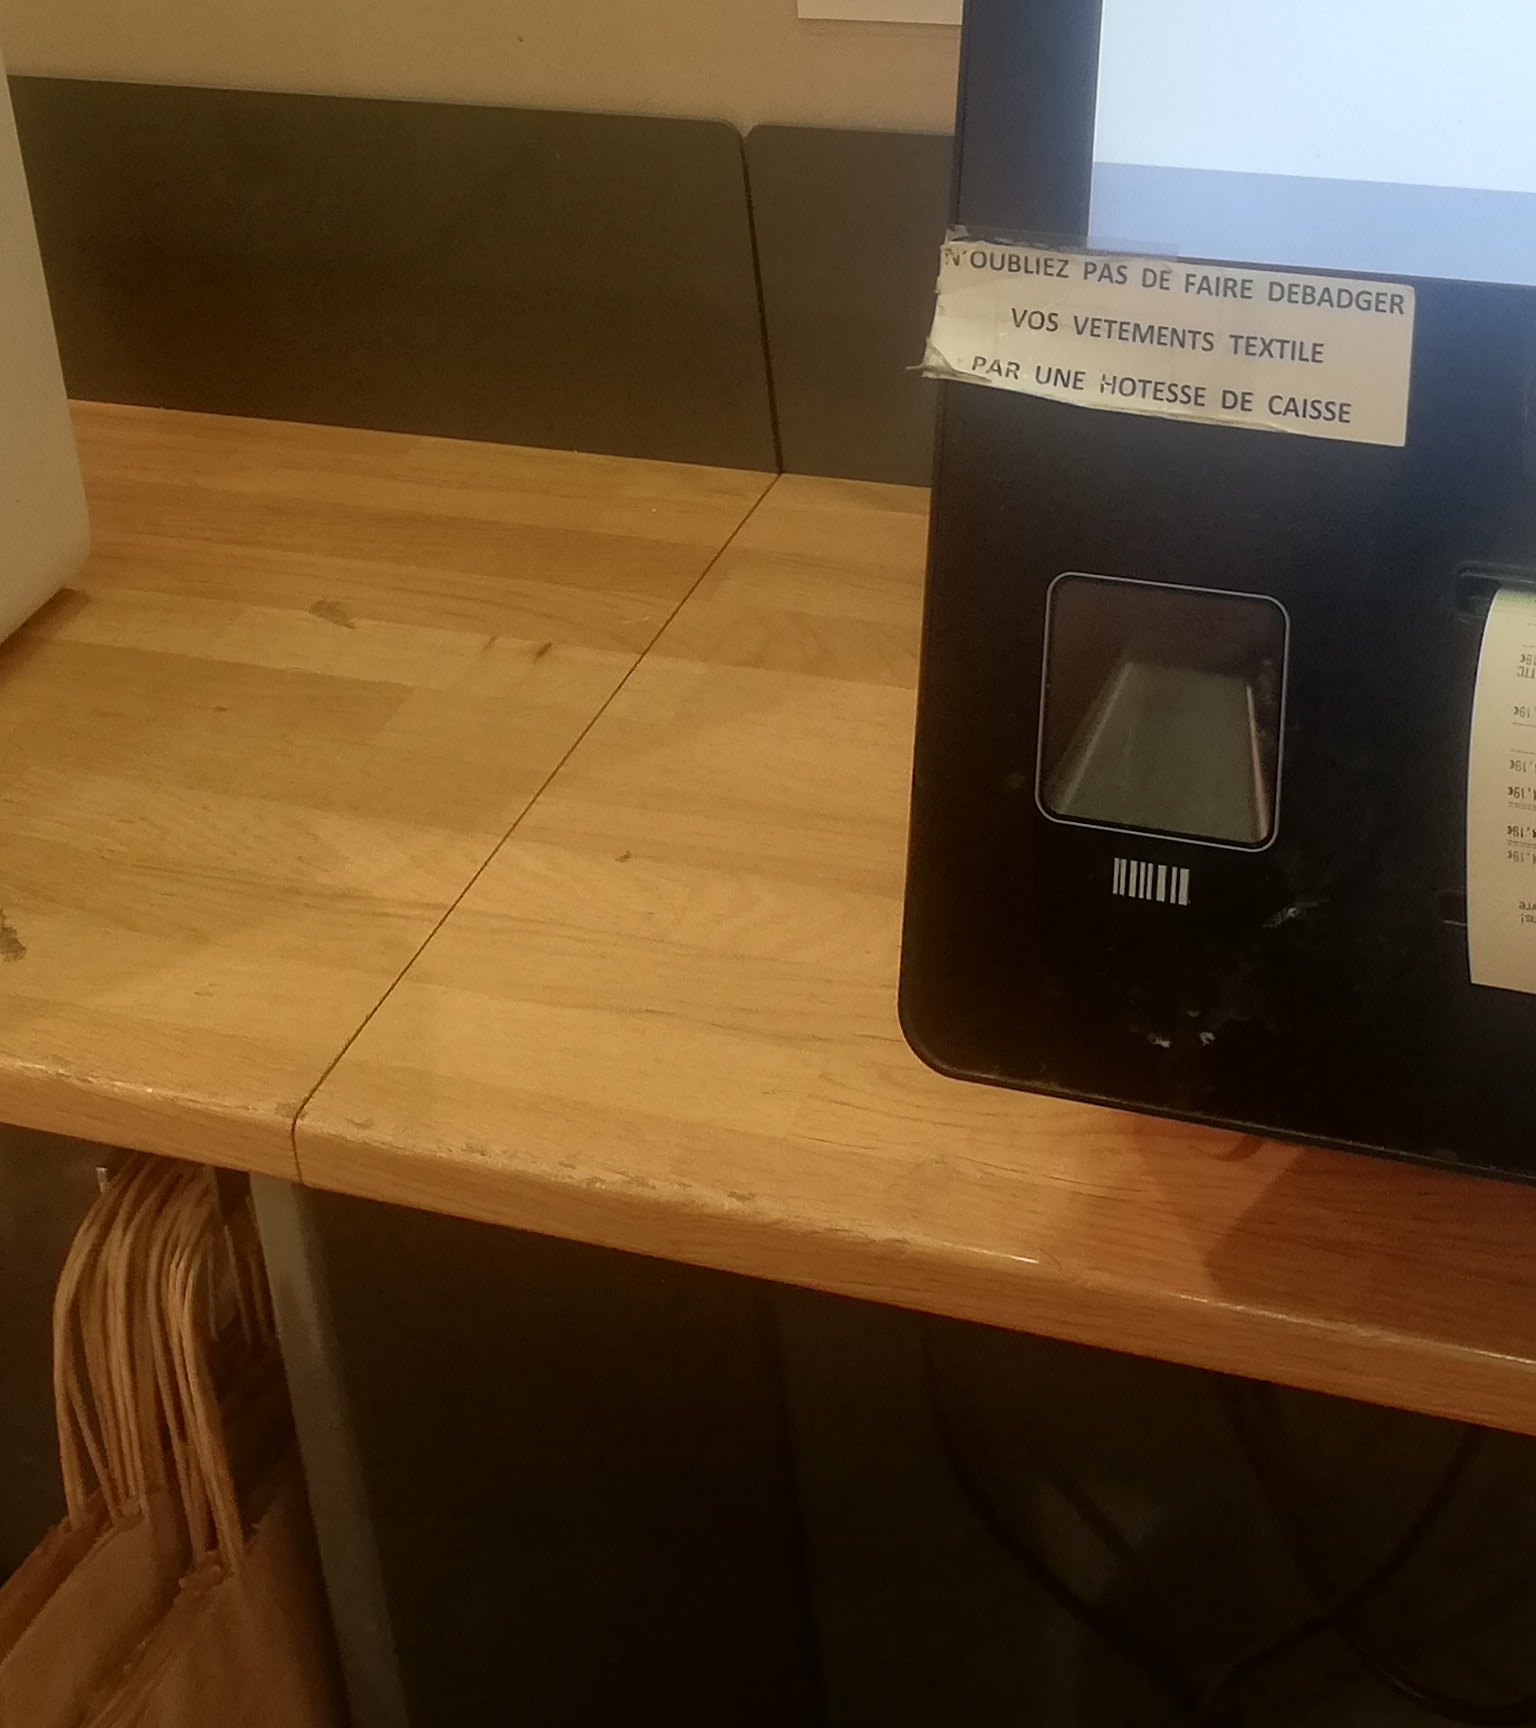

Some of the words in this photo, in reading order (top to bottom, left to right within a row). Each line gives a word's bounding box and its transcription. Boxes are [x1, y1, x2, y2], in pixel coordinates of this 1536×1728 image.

[1010, 307, 1061, 334] VOS
[1072, 314, 1216, 356] VETEMENTS
[1229, 333, 1325, 365] TEXTILE
